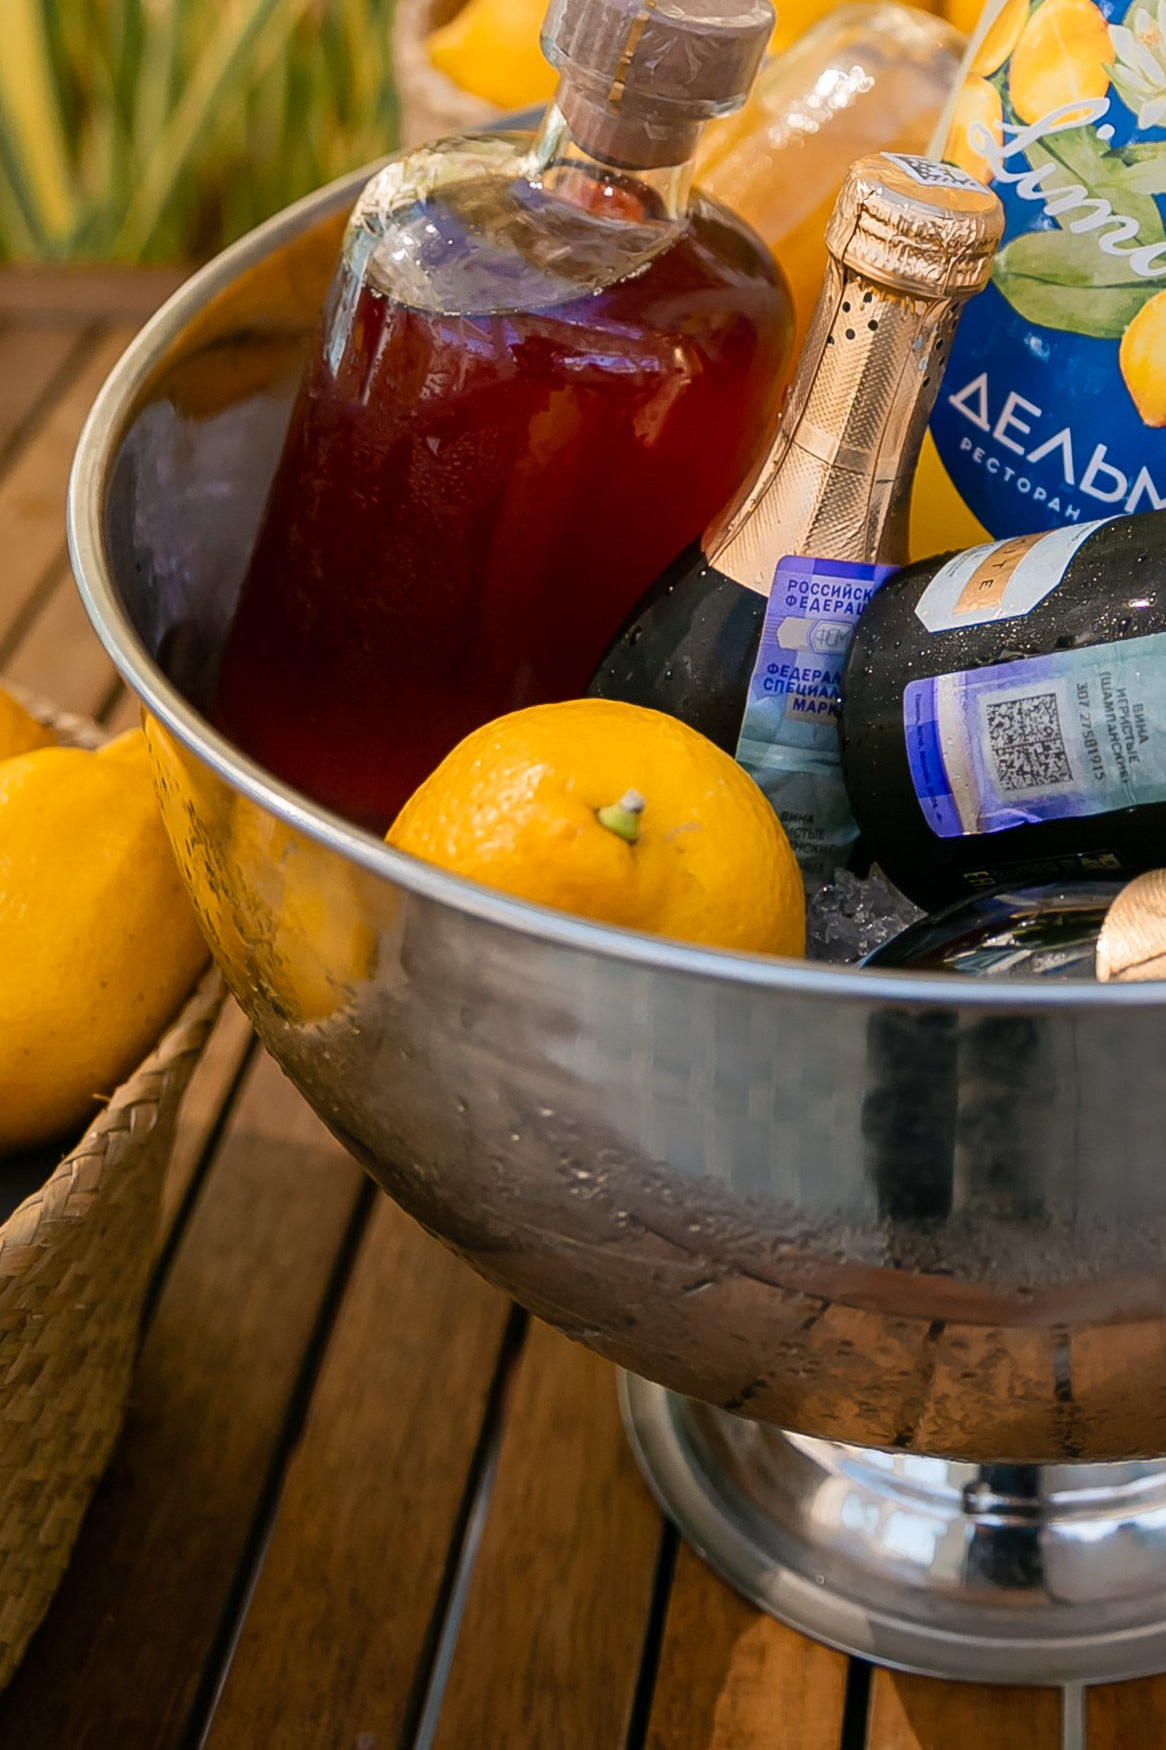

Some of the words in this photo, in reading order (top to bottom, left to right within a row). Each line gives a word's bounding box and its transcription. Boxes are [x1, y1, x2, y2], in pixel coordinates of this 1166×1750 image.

[960, 437, 1081, 521] РЕСТОРАН
[1075, 681, 1089, 709] 307
[1132, 703, 1148, 745] ВИНА
[1115, 686, 1141, 765] ИГРИСТЫЕ
